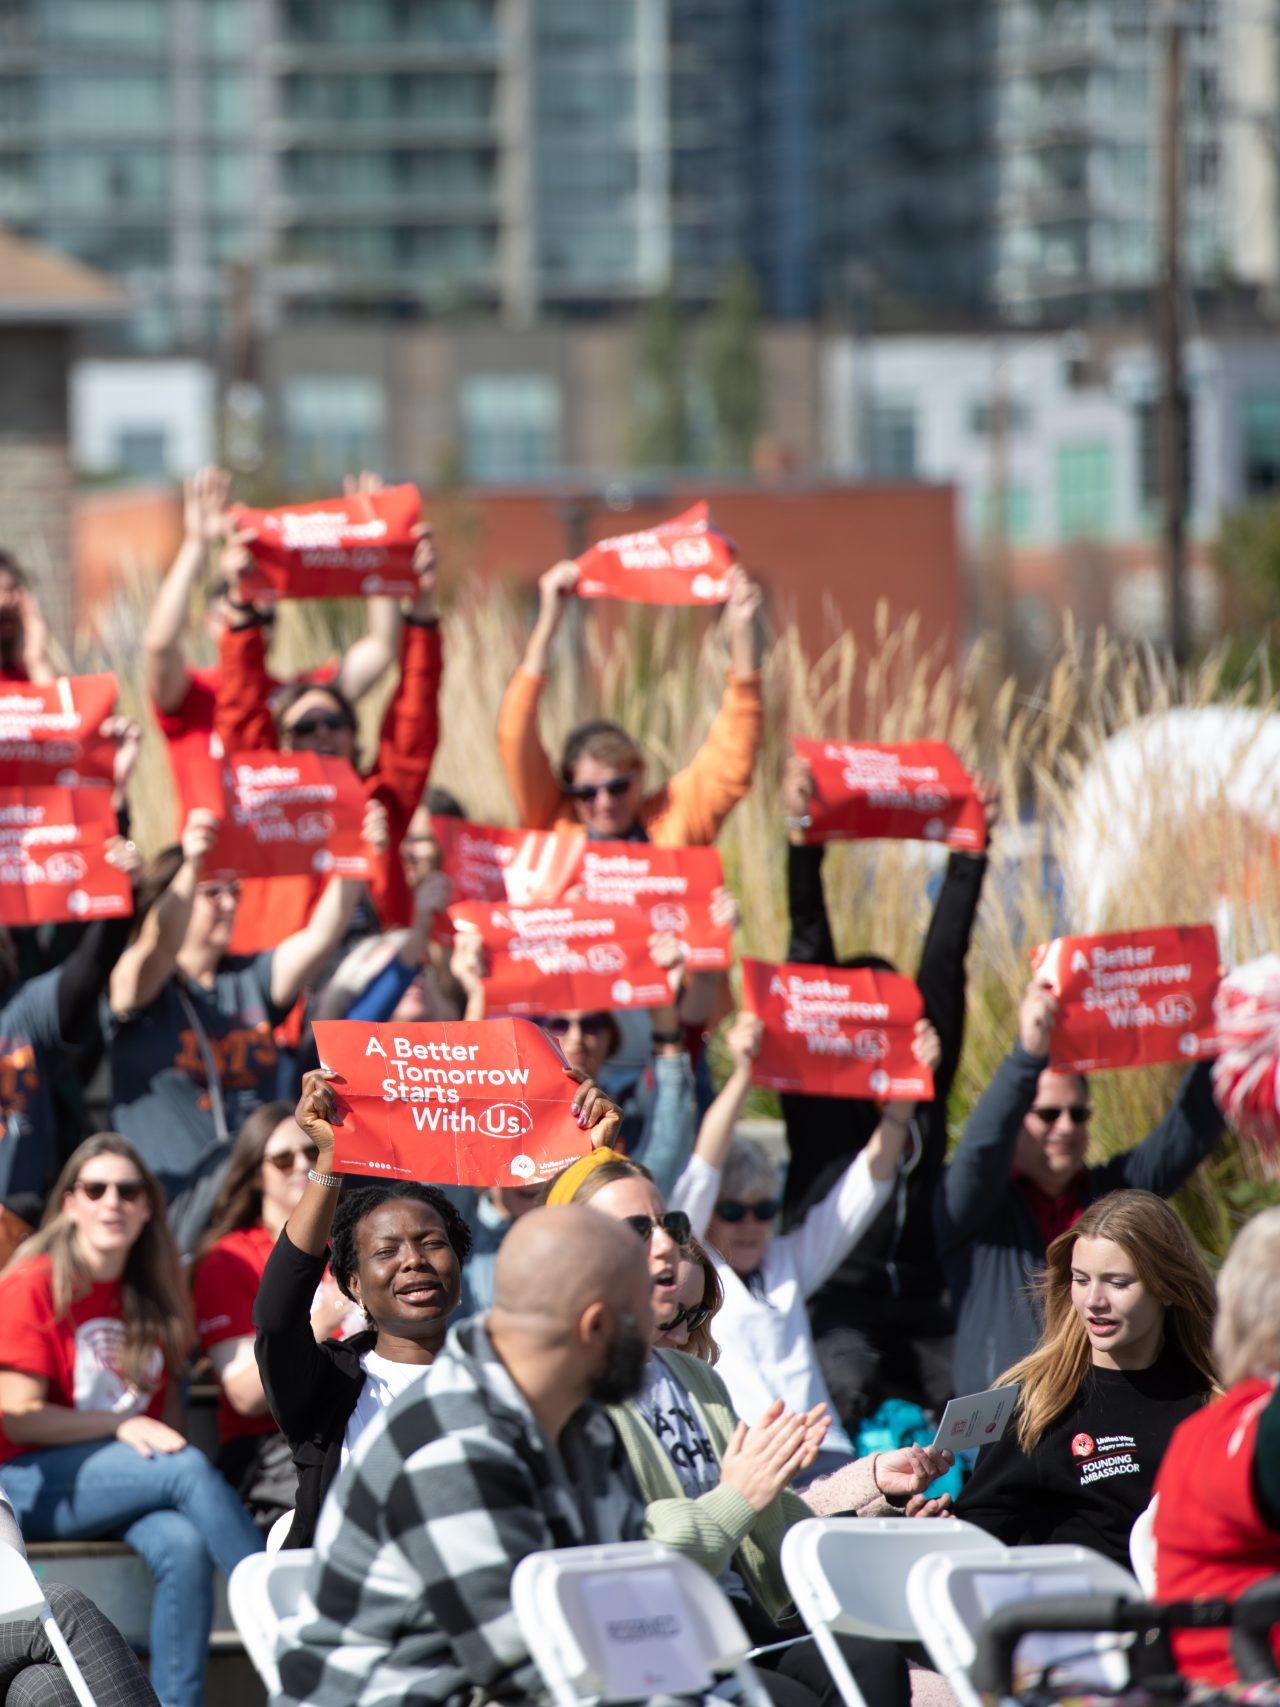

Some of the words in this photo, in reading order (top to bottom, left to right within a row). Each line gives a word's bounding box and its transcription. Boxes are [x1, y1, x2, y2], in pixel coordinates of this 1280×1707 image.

[584, 852, 650, 876] Better
[583, 870, 688, 896] Tomorrow
[508, 907, 574, 929] Better
[1071, 949, 1090, 974] A
[1090, 945, 1156, 969] Better
[787, 975, 851, 1000] Better
[1089, 963, 1192, 990] Tomorrow
[788, 994, 889, 1021] Tomorrow
[1081, 985, 1140, 1012] Starts
[1105, 1002, 1156, 1030] With
[364, 1036, 387, 1058] A
[393, 1037, 479, 1062] Better
[390, 1060, 530, 1086] Tomorrow
[381, 1079, 460, 1104] Starts
[411, 1107, 476, 1133] With
[485, 1108, 527, 1135] Us.
[1096, 1435, 1119, 1445] United
[1119, 1435, 1134, 1443] Way
[1079, 1463, 1141, 1486] AMBASSADOR
[1082, 1453, 1132, 1474] FOUNDING
